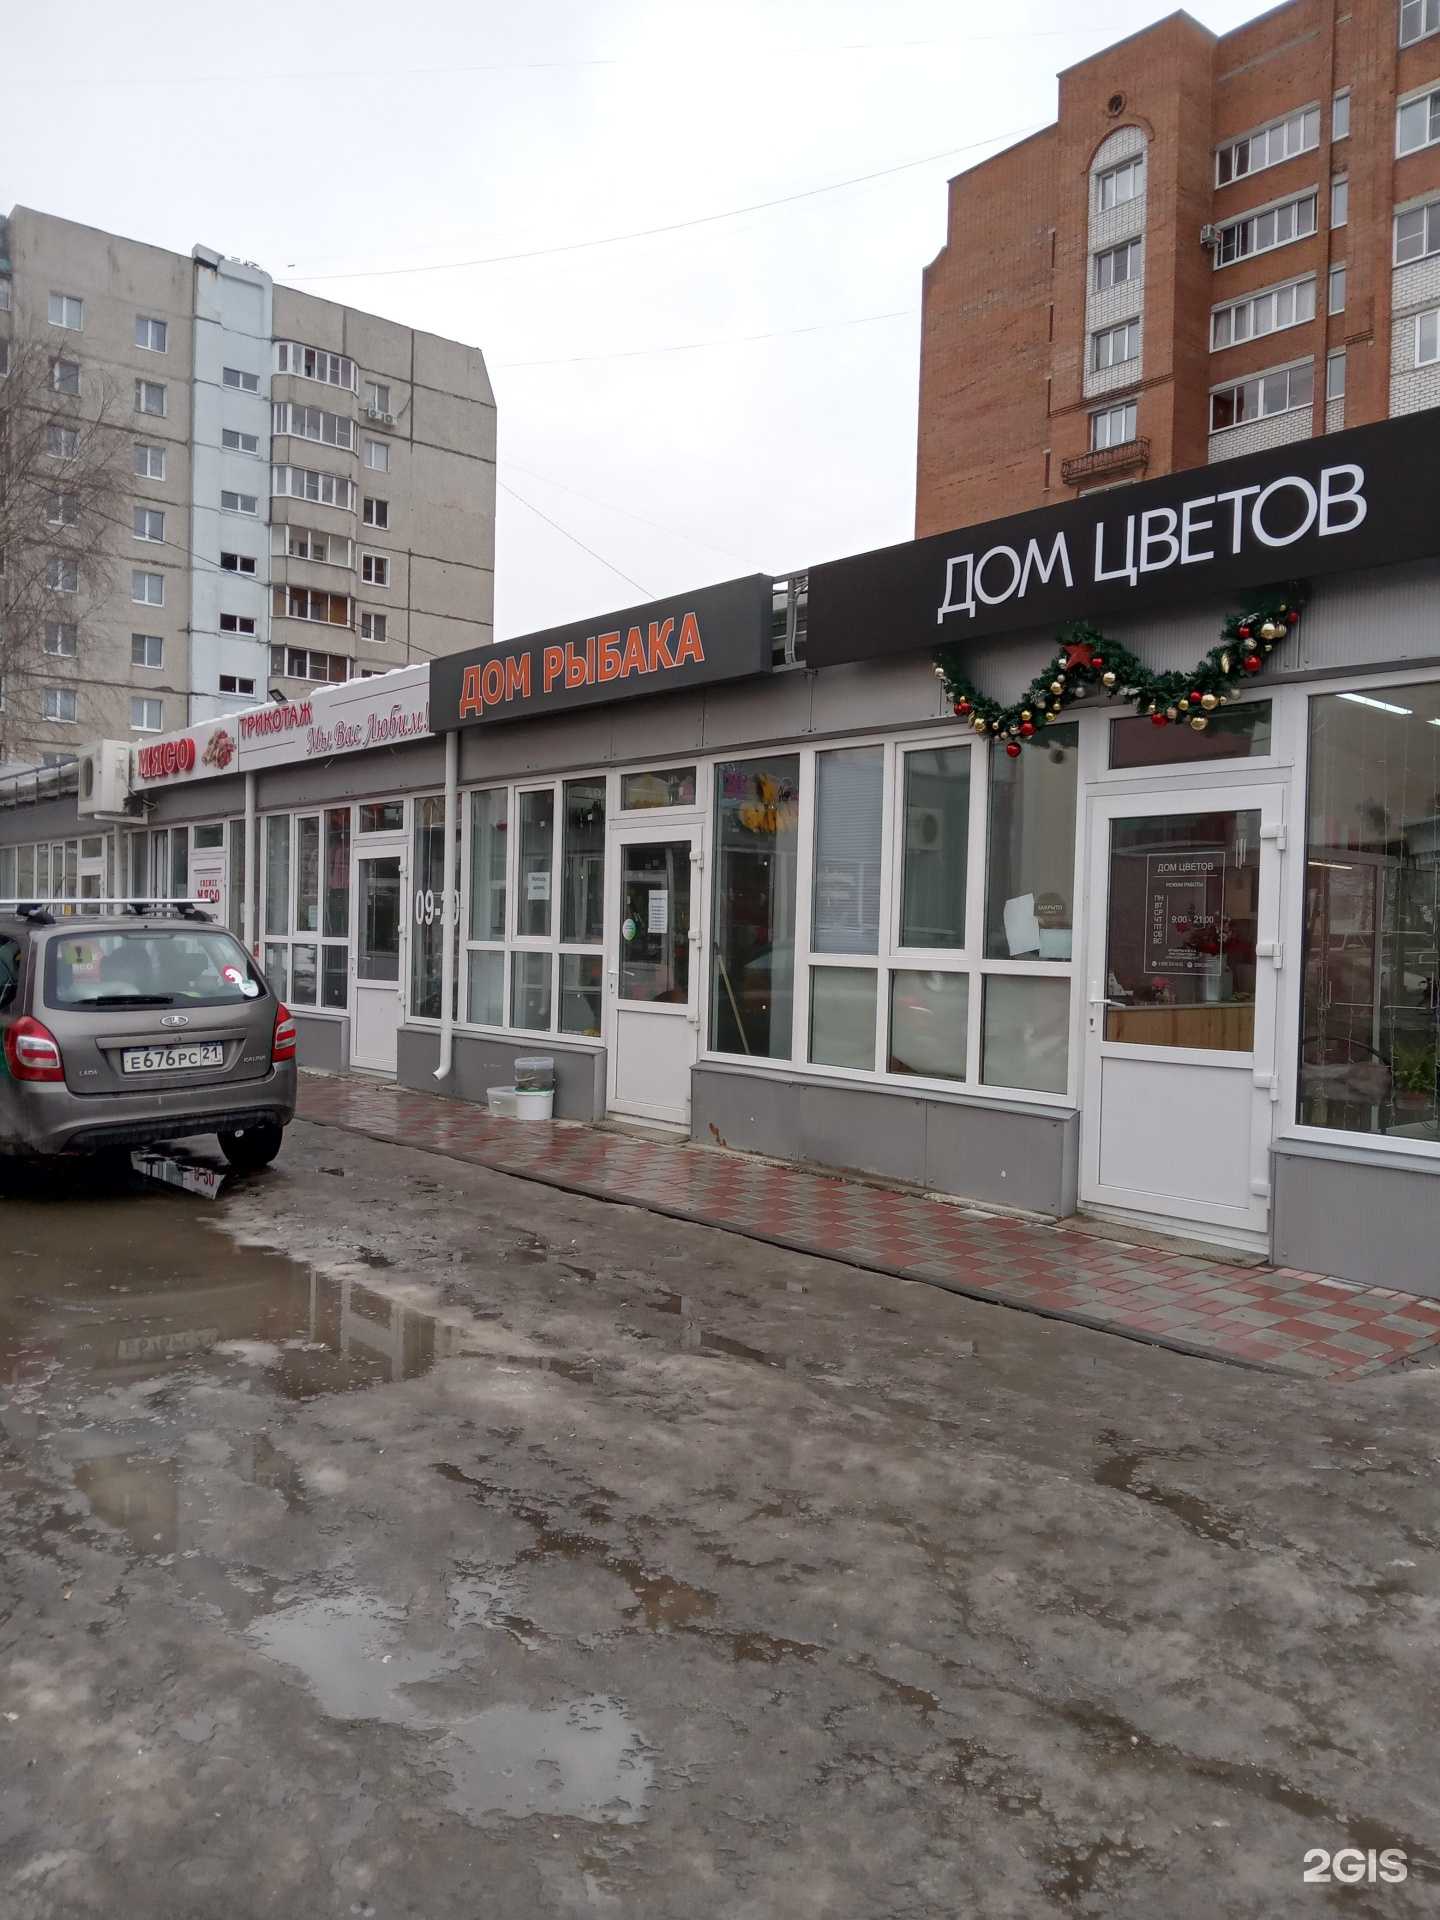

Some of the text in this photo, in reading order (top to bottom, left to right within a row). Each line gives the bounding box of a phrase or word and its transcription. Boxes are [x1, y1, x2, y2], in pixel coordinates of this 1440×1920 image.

[937, 463, 1368, 624] ДОМ ЦВЕТОВ
[459, 612, 705, 719] ДОМ РЫБАКА
[239, 701, 313, 738] ТРИКОТАЖ
[306, 702, 429, 754] Мы Вас Любим!
[137, 737, 195, 778] МЯСО
[1157, 862, 1214, 873] ДОМ ЦВЕТОВ
[202, 1046, 218, 1060] 21
